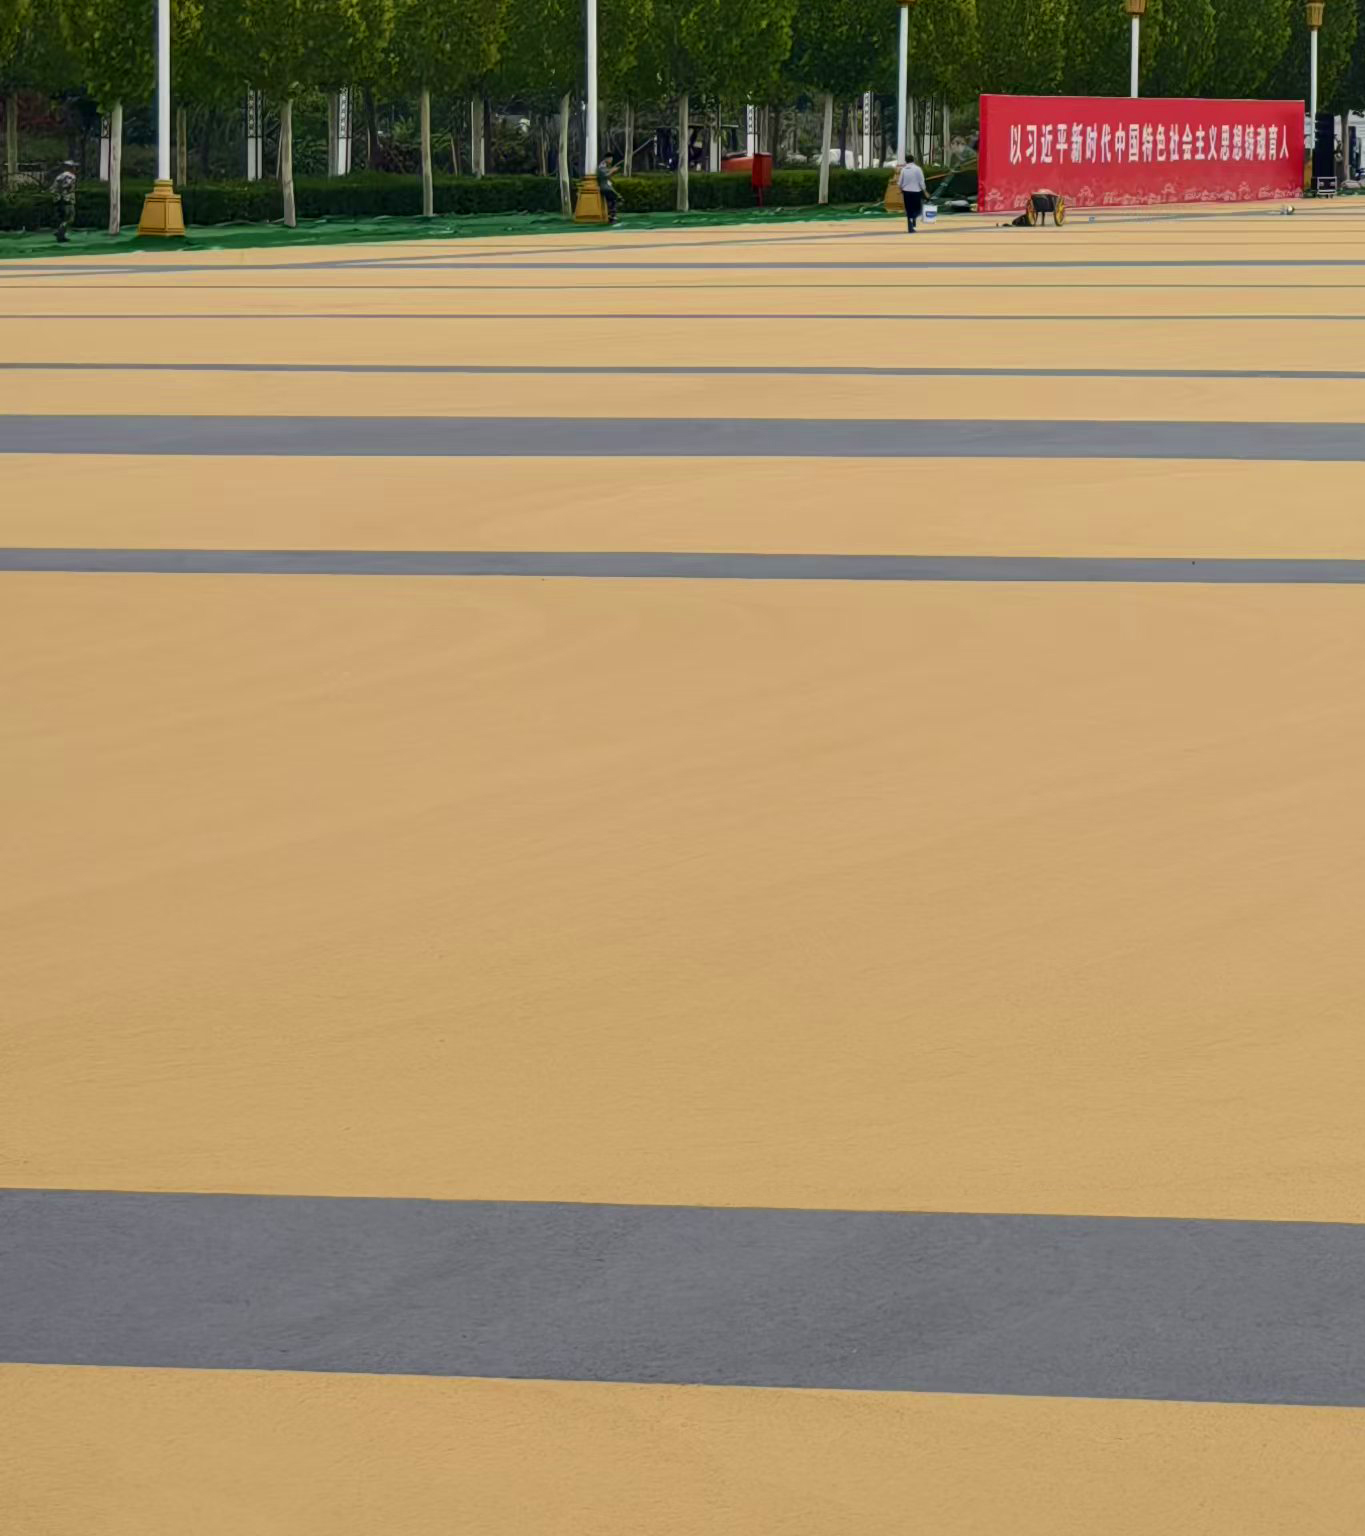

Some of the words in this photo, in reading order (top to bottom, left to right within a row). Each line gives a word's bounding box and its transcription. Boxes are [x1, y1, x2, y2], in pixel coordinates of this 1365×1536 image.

[1008, 122, 1290, 166] 以习近平新时代中国特色社会主义思想铸魂育人
